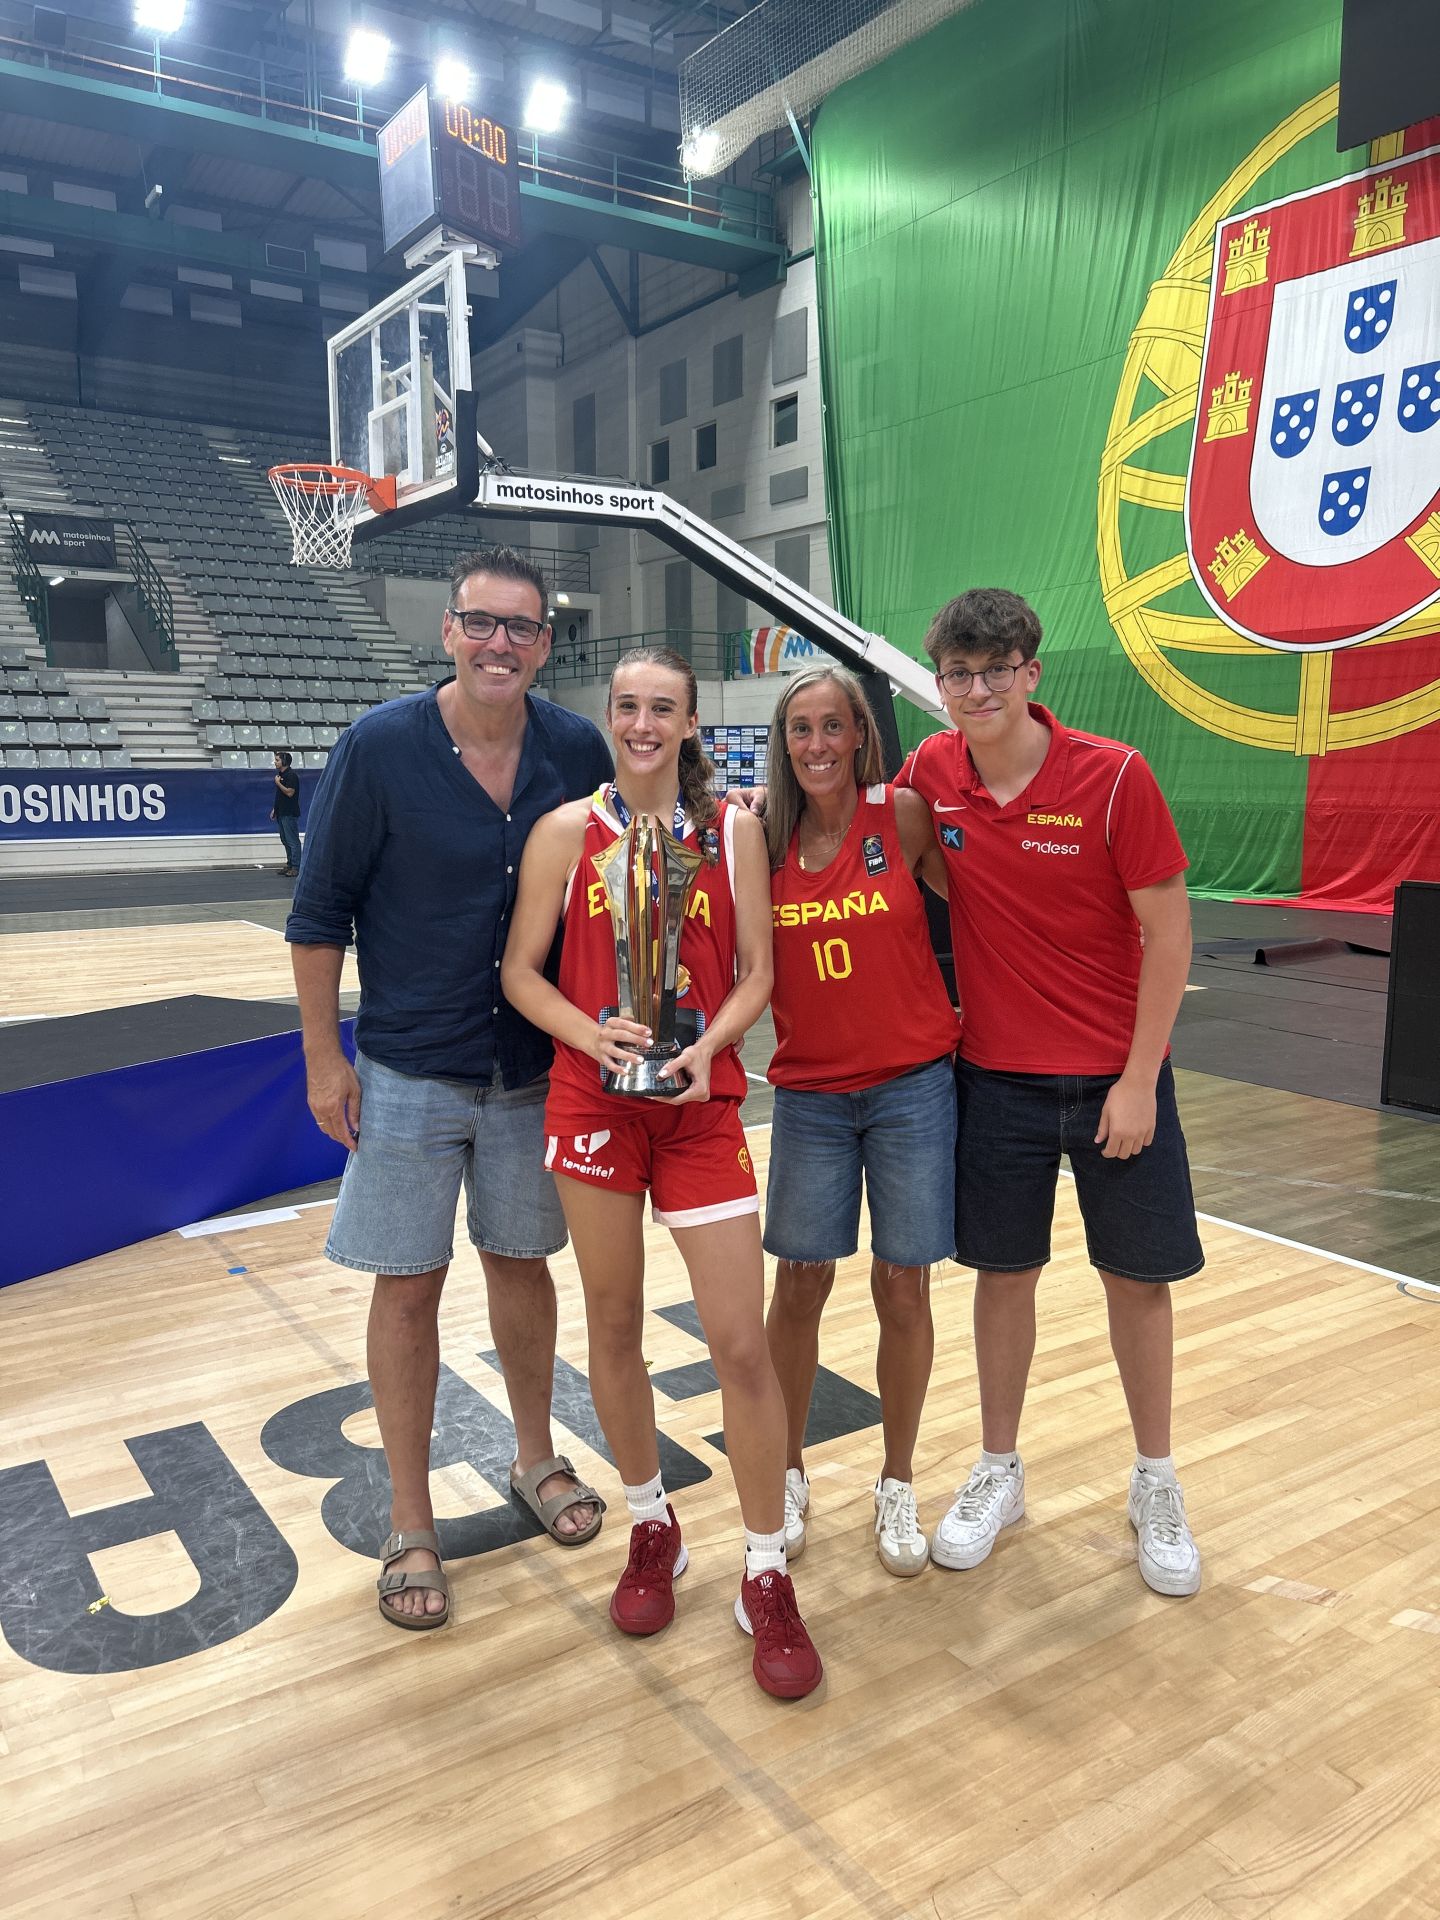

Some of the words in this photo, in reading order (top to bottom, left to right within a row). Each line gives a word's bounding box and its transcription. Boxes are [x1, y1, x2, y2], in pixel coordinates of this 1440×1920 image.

[445, 99, 507, 164] 00:00
[496, 483, 604, 506] matosinhos
[609, 494, 655, 511] sport
[62, 531, 111, 542] matosinhos
[0, 783, 166, 824] OSINHOS
[1026, 813, 1083, 828] ESPAÑA
[1021, 839, 1080, 855] endesa
[867, 856, 883, 867] FIBA
[811, 937, 853, 982] 10
[562, 1156, 615, 1180] tenerife!
